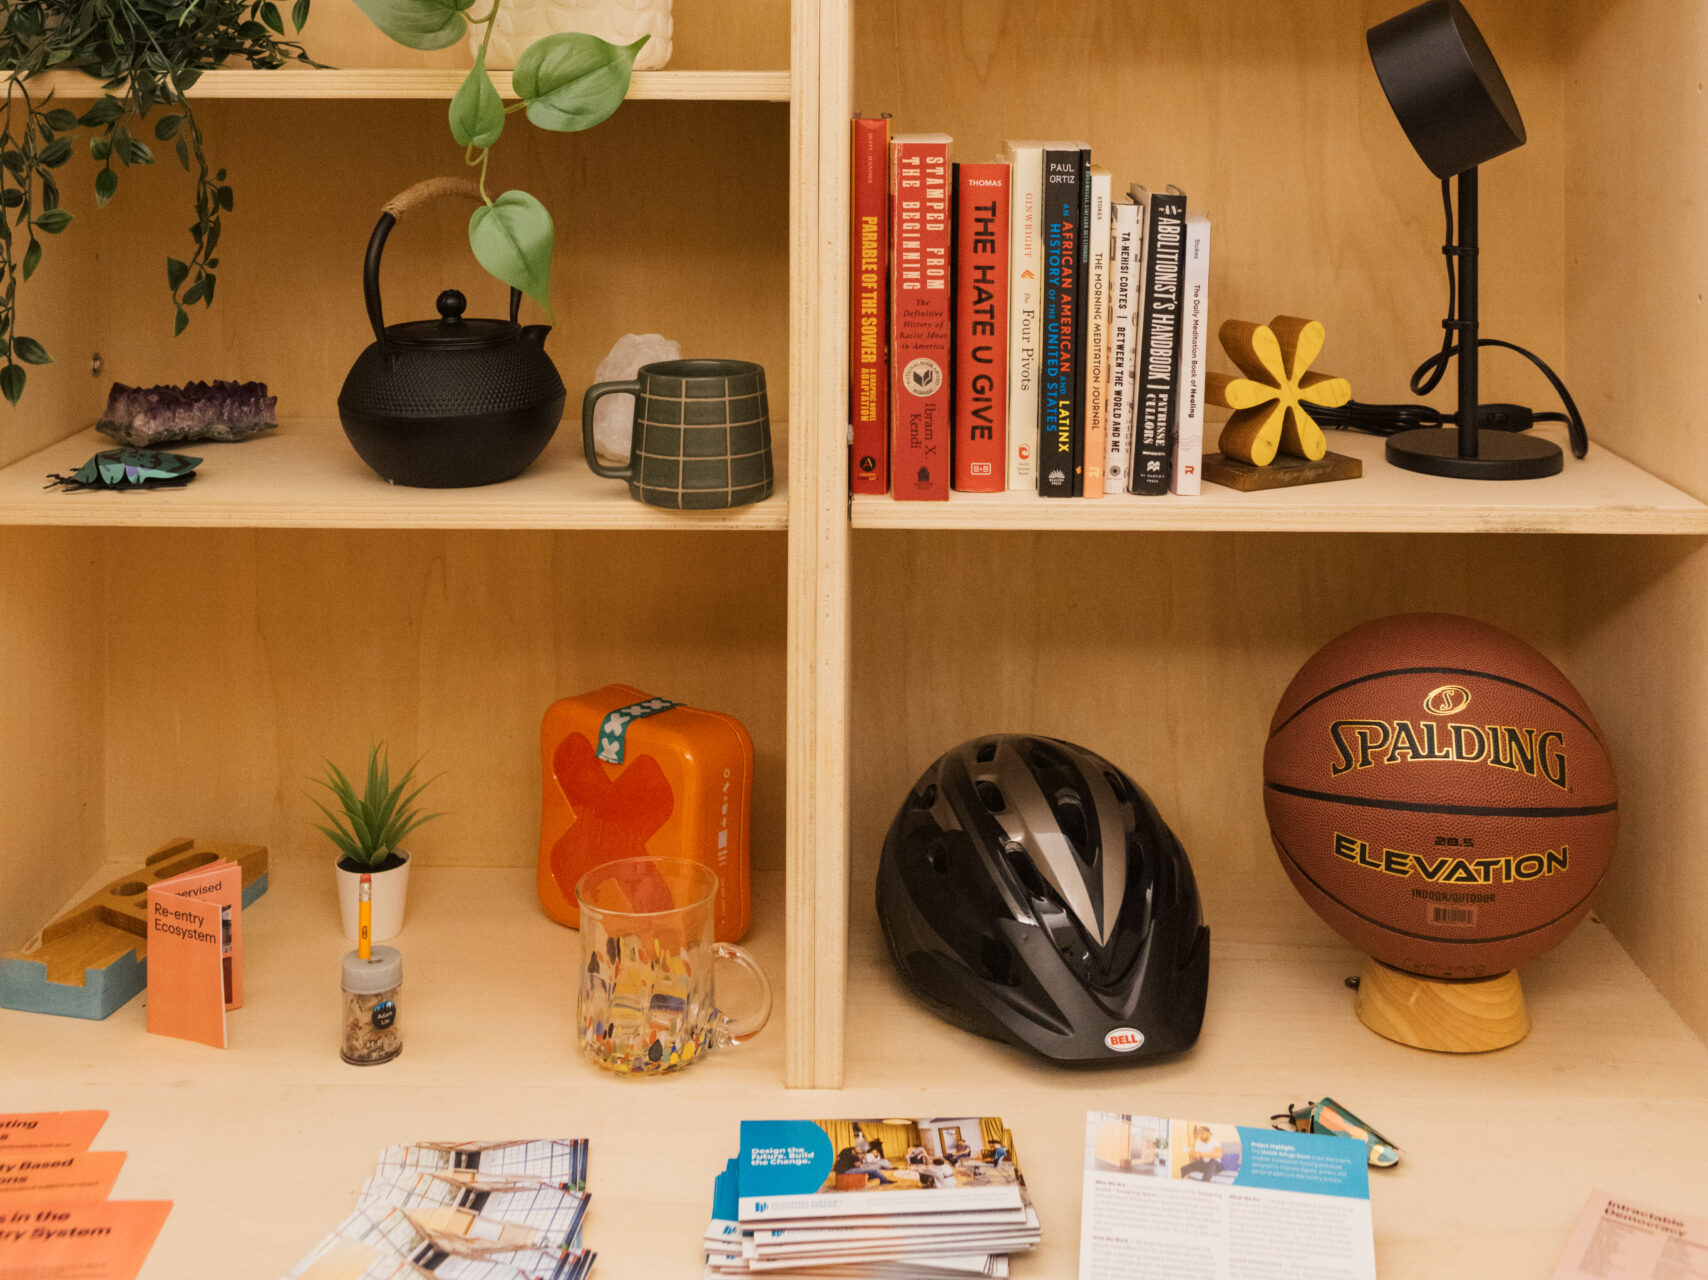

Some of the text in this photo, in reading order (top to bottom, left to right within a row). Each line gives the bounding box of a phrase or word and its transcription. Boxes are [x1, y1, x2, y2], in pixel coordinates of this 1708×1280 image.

[968, 179, 1002, 187] THOMAS
[1049, 175, 1075, 184] ORTIZ
[1050, 163, 1075, 172] PAUL
[902, 156, 921, 290] THE BEGINNING
[926, 156, 945, 290] STAMPED FROM
[1023, 192, 1033, 258] GINWRIGHT
[1049, 223, 1061, 286] HISTORY
[1119, 231, 1131, 310] TA-NEHISI COATES
[861, 216, 878, 363] PARABLE OF THE SOWER
[903, 310, 943, 318] Definitive
[1048, 289, 1056, 300] OF
[1148, 217, 1181, 381] ABOLITIONIST'S HANDBOOK
[899, 331, 948, 339] Racist Ideas
[935, 320, 944, 329] of
[971, 200, 997, 441] THE HATE U GIVE
[1020, 293, 1035, 392] The Four Pivots
[1058, 203, 1074, 453] AN AFRICAN AMERICAN AND LATINX
[1092, 253, 1103, 430] THE MORNING MEDITATION JOURNAL
[1047, 323, 1059, 377] UNITED
[1188, 285, 1201, 419] The Daily Meditation Book of Healing
[860, 368, 870, 422] ADAPTATION
[1046, 382, 1057, 433] STATES
[1111, 326, 1126, 454] BETWEEN THE WORLD AND ME
[910, 413, 922, 449] Kendi
[923, 403, 937, 459] Ibram X.
[1143, 394, 1156, 444] CULLORS
[1155, 394, 1169, 447] PATRISSE
[1329, 719, 1568, 791] SPALDING
[1334, 831, 1569, 884] ELEVATION
[1434, 836, 1475, 848] 28.5
[154, 902, 205, 929] Re-entry
[1411, 888, 1497, 904] INDOOR/OUTDOOR
[154, 918, 217, 945] Ecosystem
[1110, 1034, 1139, 1046] BELL
[19, 1157, 75, 1171] Based
[751, 1146, 805, 1155] Design the
[770, 1158, 812, 1166] Change.
[788, 1151, 815, 1159] Build
[10, 1209, 71, 1223] in the
[30, 1226, 112, 1241] System
